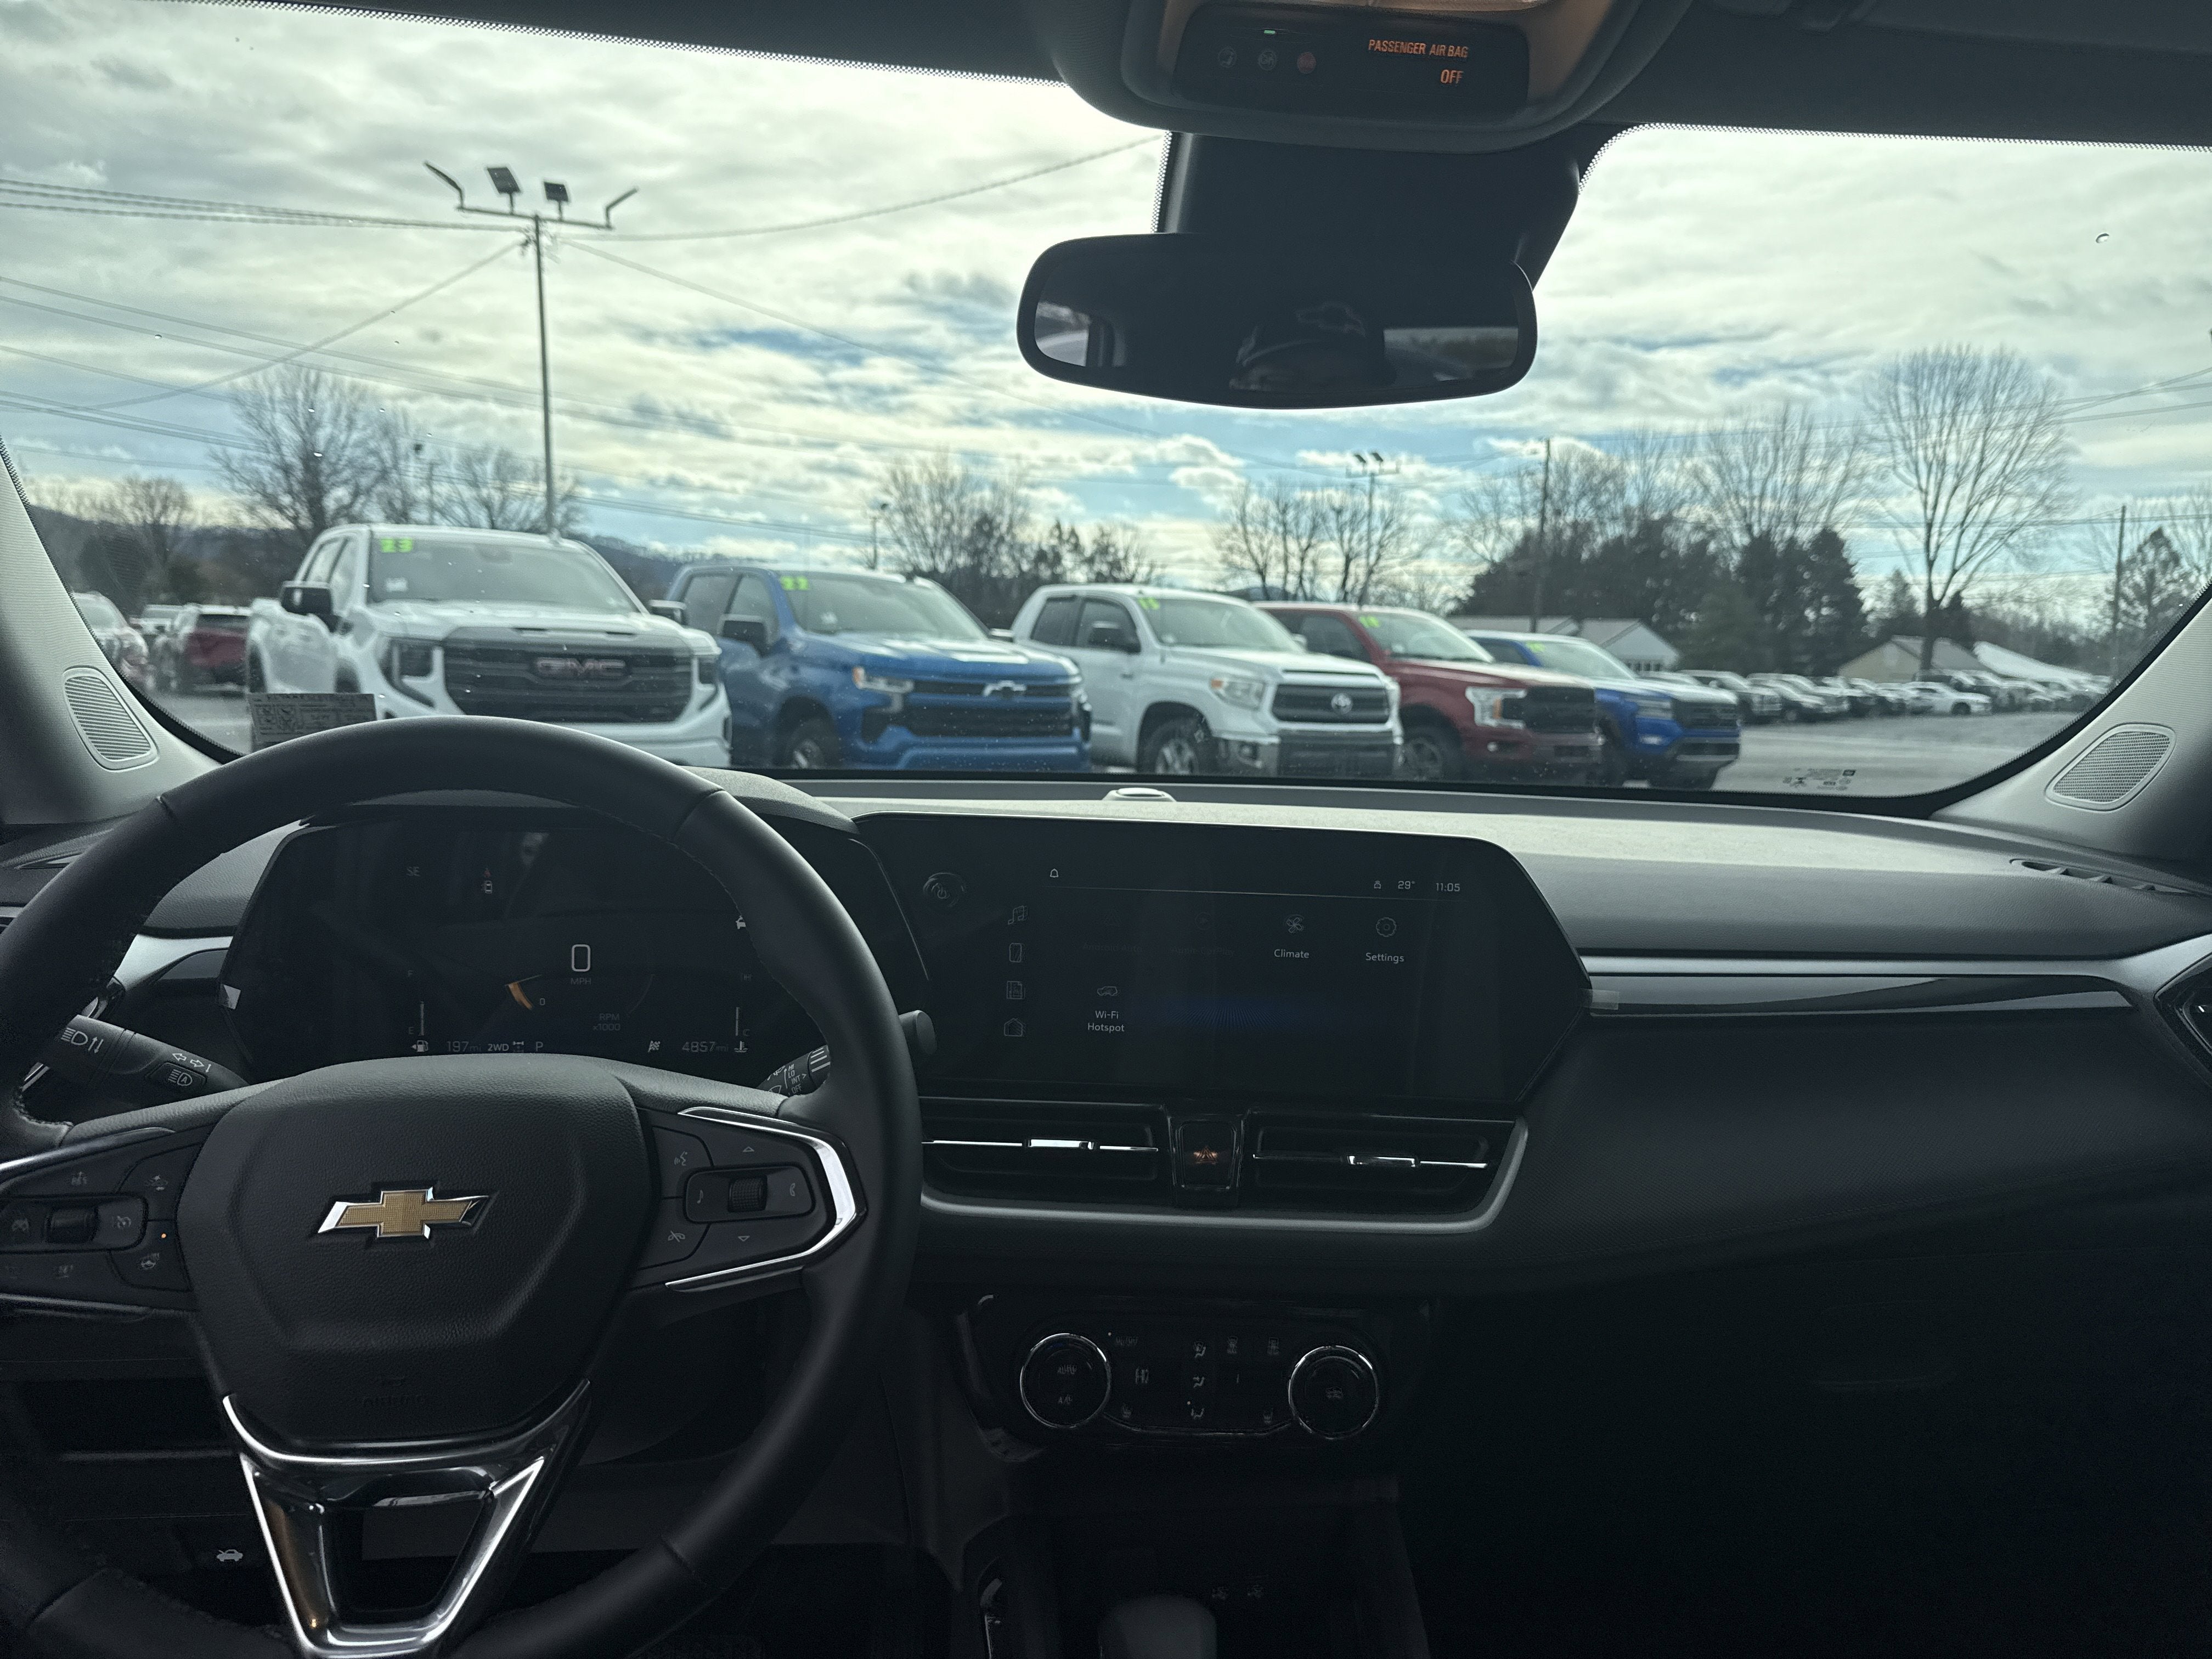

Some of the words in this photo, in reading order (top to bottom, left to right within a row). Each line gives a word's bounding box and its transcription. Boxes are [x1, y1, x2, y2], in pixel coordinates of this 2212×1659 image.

[1368, 39, 1426, 55] PASSENGER
[1429, 44, 1446, 56] AIR
[1447, 45, 1469, 58] BAG
[1440, 69, 1464, 84] OFF
[537, 657, 626, 677] GMC
[1436, 883, 1461, 892] 11:05
[571, 944, 591, 972] 0
[1274, 949, 1310, 958] Climate
[1365, 952, 1404, 964] Settings
[1095, 1010, 1119, 1019] Wi-Fi
[1087, 1022, 1125, 1034] Hotspot
[487, 1043, 510, 1052] 2WD
[788, 1070, 795, 1079] LO
[791, 1075, 800, 1085] INT
[791, 1084, 802, 1094] OFF
